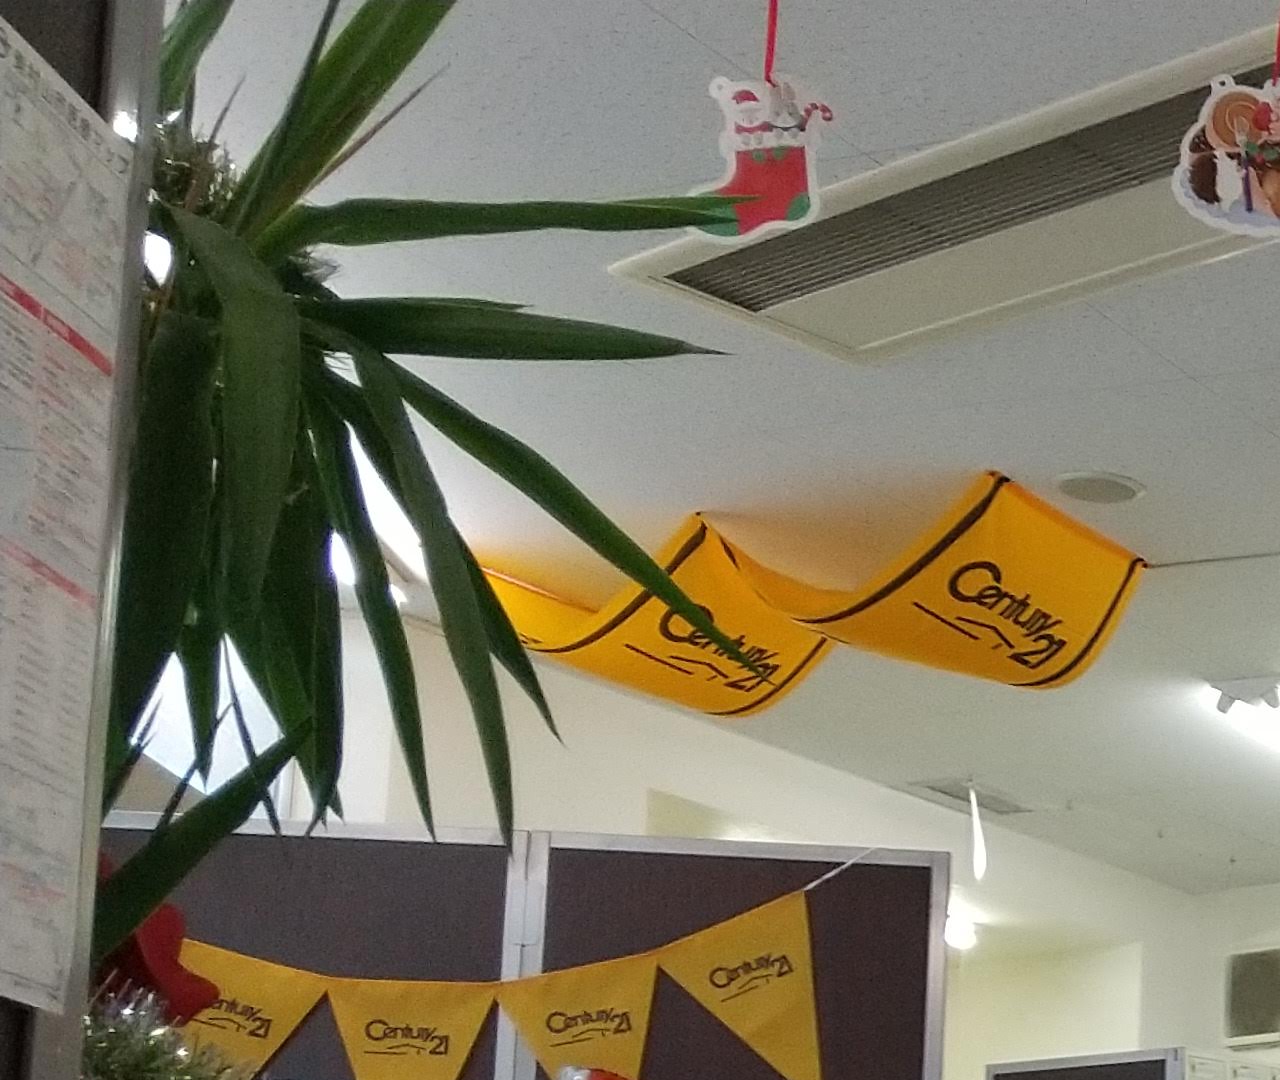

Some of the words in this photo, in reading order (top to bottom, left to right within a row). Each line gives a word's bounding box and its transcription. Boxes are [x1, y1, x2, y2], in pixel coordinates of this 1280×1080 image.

[948, 561, 1063, 638] Century
[1007, 637, 1067, 669] 21
[709, 953, 774, 988] Century
[771, 954, 794, 977] 21
[211, 998, 264, 1021] entury
[249, 1017, 272, 1039] 21
[364, 1018, 438, 1042] Century
[428, 1034, 449, 1055] 21
[546, 1007, 614, 1033] Century
[611, 1011, 632, 1034] 21
